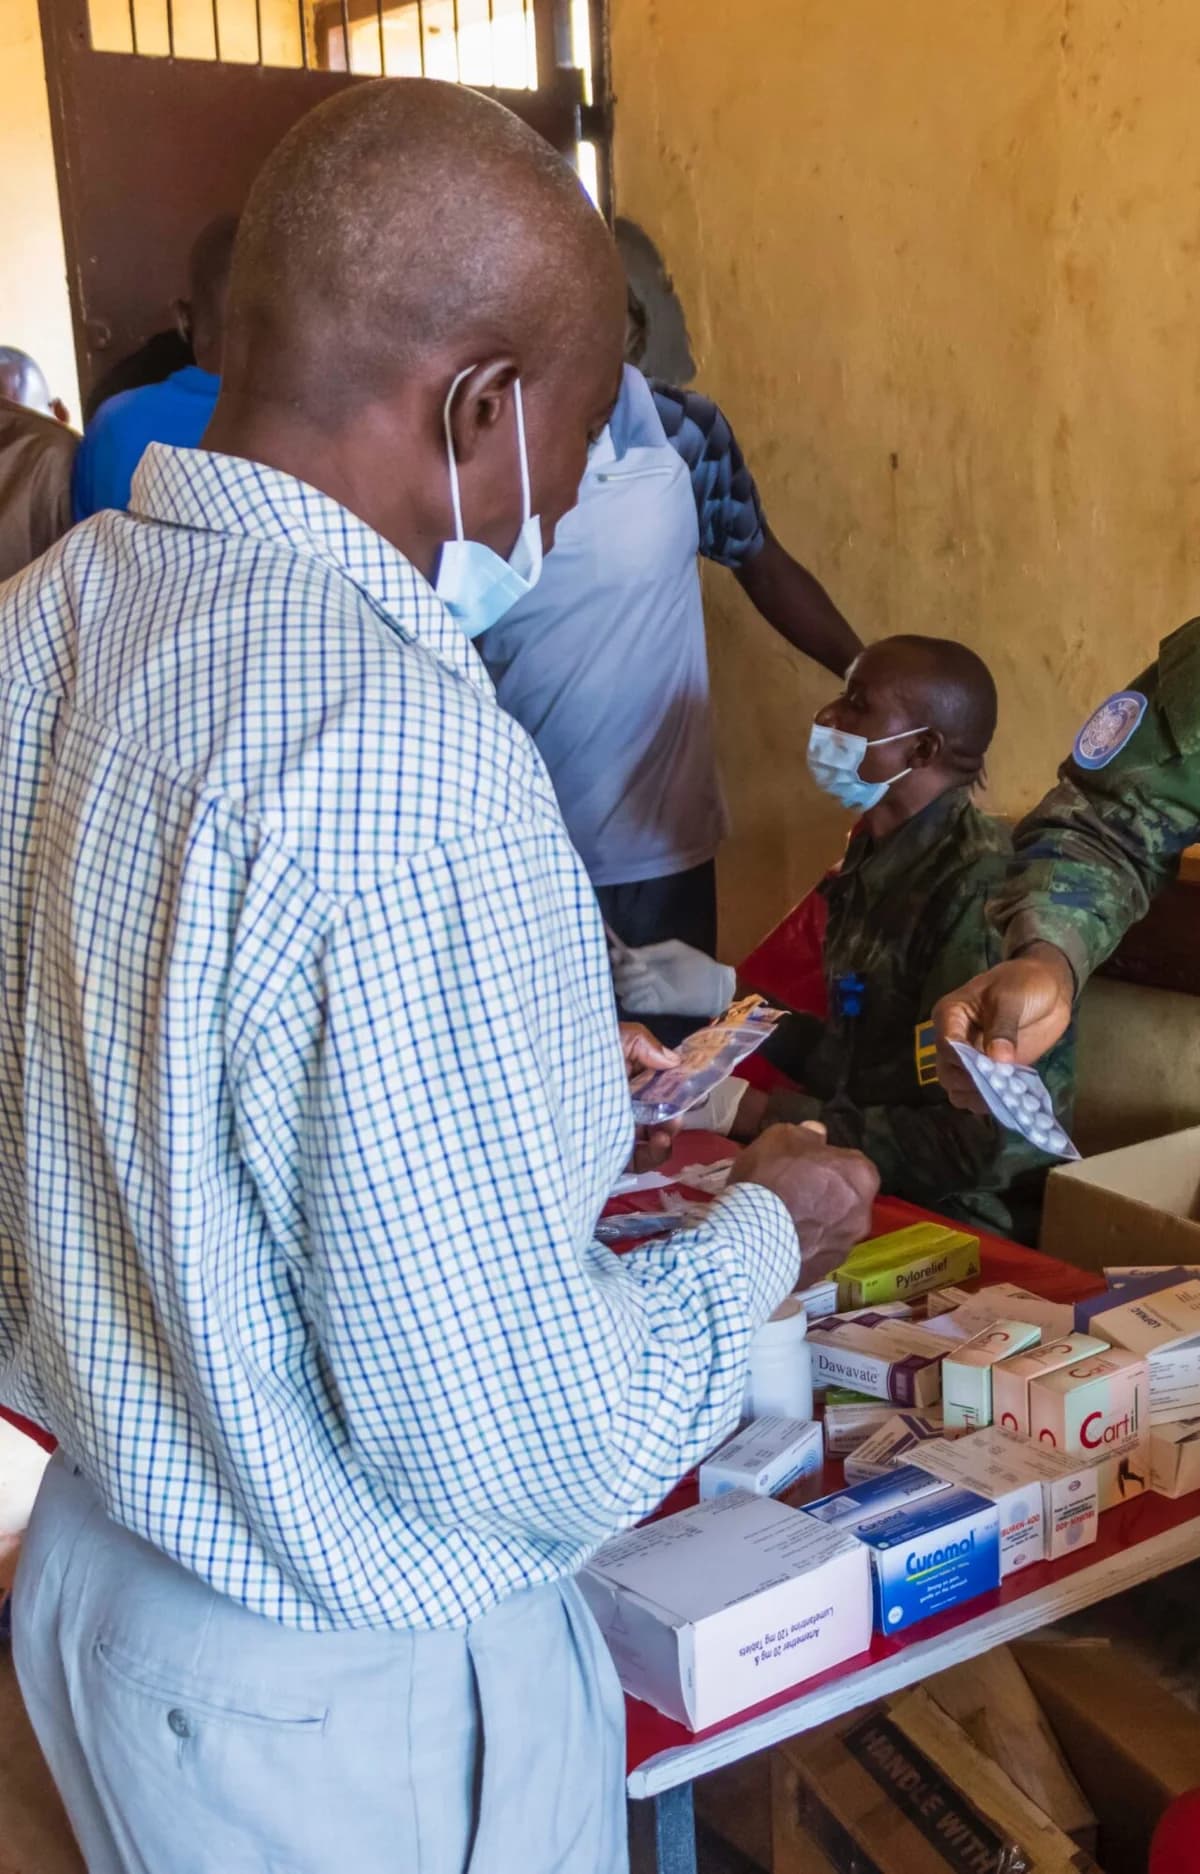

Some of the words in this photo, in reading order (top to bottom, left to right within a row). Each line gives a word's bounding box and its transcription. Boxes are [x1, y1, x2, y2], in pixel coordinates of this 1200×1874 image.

[896, 1256, 948, 1289] Pylorelief
[818, 1354, 878, 1384] Dawavate
[1080, 1384, 1138, 1449] Cartil
[906, 1529, 974, 1575] Curamol
[790, 1606, 834, 1633] Lumefantrine
[764, 1633, 777, 1645] mg
[777, 1628, 789, 1641] 120
[783, 1628, 820, 1650] Artemether
[739, 1641, 763, 1657] Tablets
[761, 1650, 773, 1661] mg
[773, 1645, 783, 1657] 20
[754, 1655, 760, 1666] &
[861, 1727, 945, 1817] HANDLE
